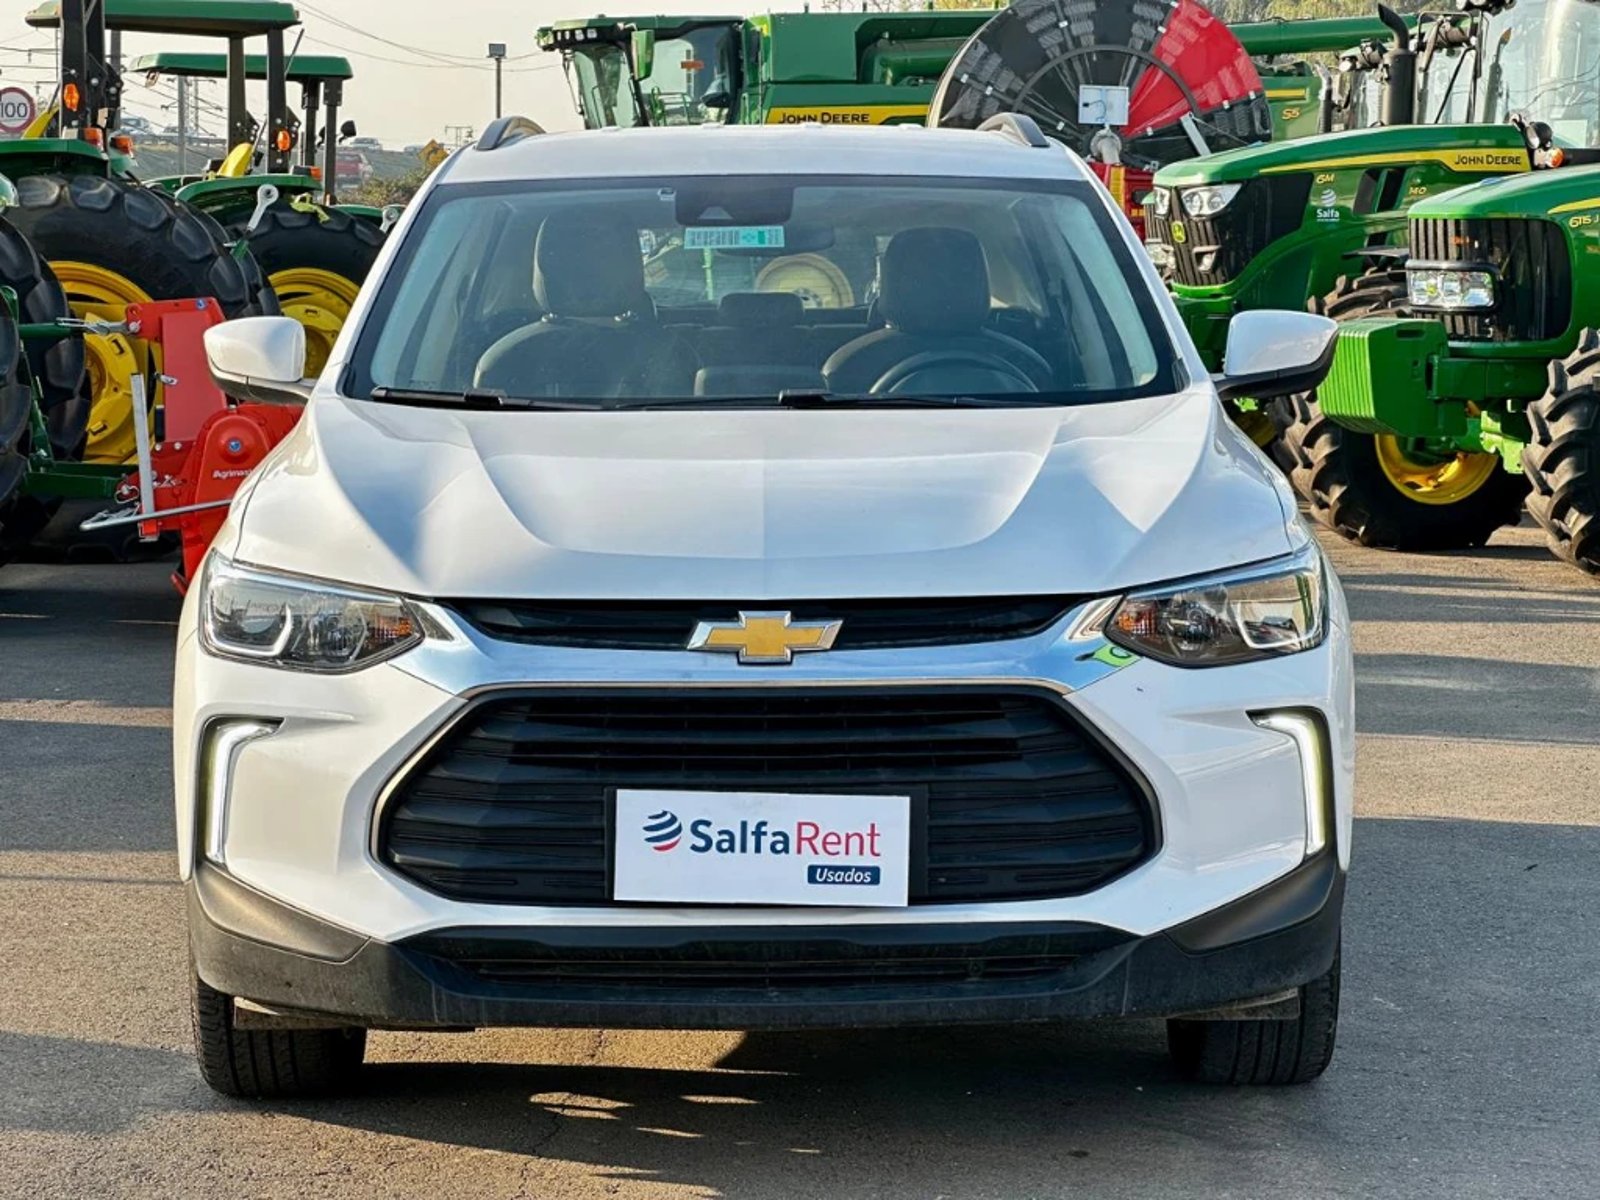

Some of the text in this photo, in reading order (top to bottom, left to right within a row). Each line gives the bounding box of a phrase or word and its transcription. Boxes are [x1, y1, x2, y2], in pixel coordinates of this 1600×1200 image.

[0, 102, 28, 118] 100
[779, 112, 870, 124] JOHN DEERE
[1455, 154, 1522, 165] JOHN DEERE
[1316, 208, 1340, 219] Salfa
[815, 867, 872, 883] Usados
